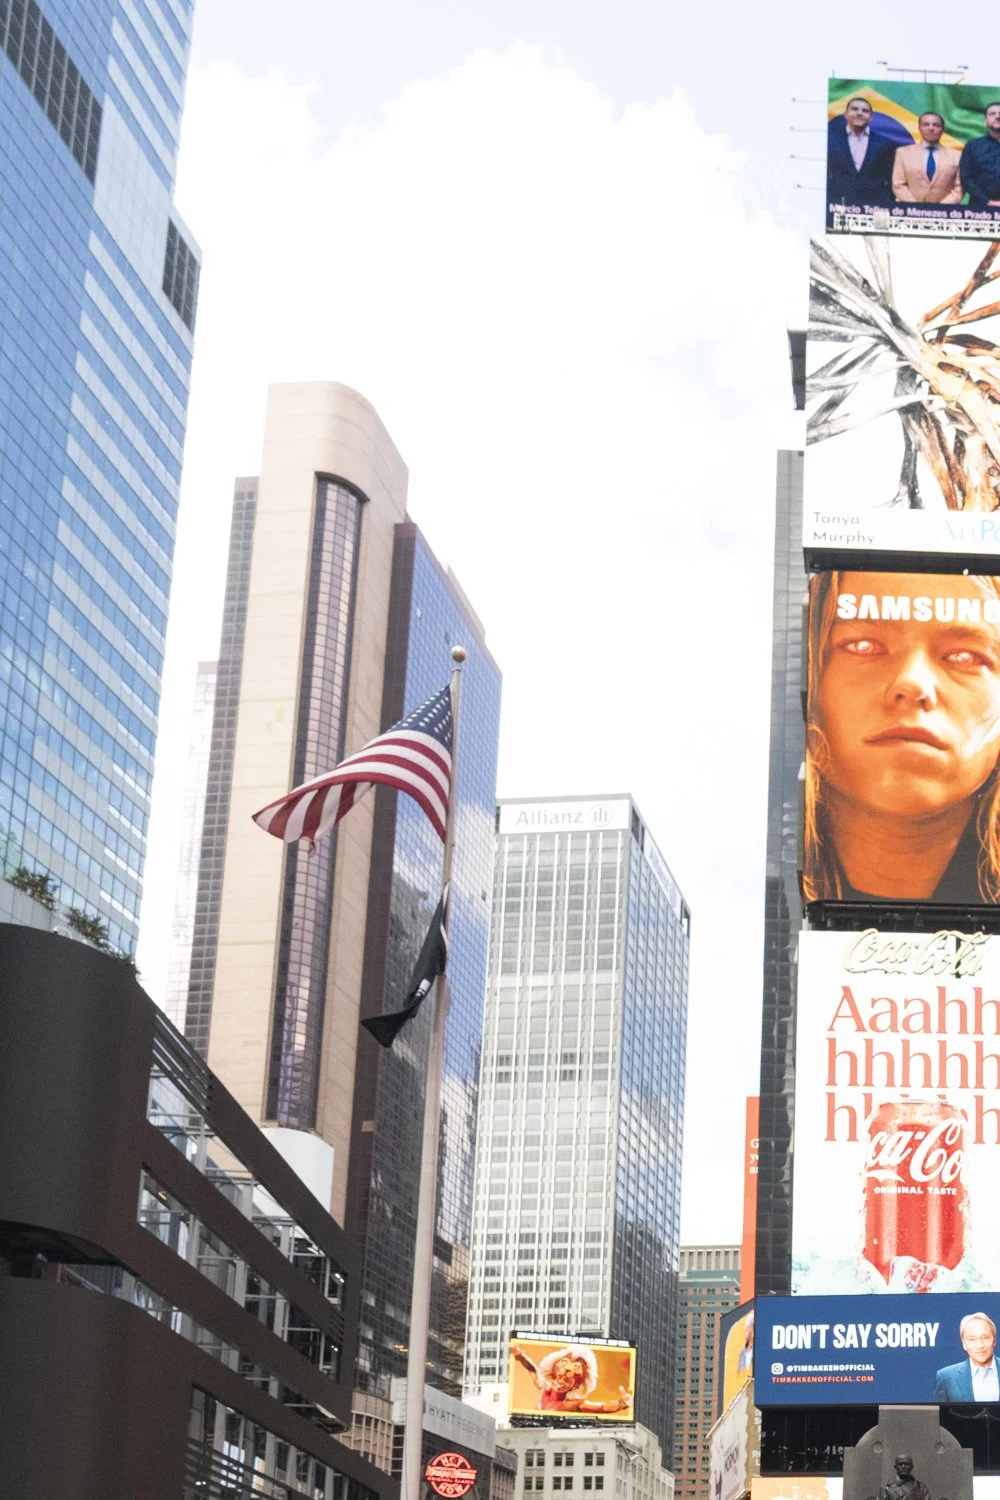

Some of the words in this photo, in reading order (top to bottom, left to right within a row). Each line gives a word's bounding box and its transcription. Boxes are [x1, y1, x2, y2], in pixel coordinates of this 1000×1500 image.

[892, 206, 904, 216] de
[906, 207, 948, 218] Menezes
[950, 208, 962, 218] do
[964, 209, 991, 220] Prado
[813, 511, 860, 526] Tanya
[813, 531, 875, 545] Murphy
[515, 809, 584, 827] Allianz
[843, 928, 992, 978] Coca-Cola
[874, 1186, 924, 1195] ORIGINAL
[927, 1186, 957, 1196] TASTE
[771, 1323, 830, 1350] DON'T
[832, 1323, 872, 1349] SAY
[875, 1322, 940, 1348] SORRY
